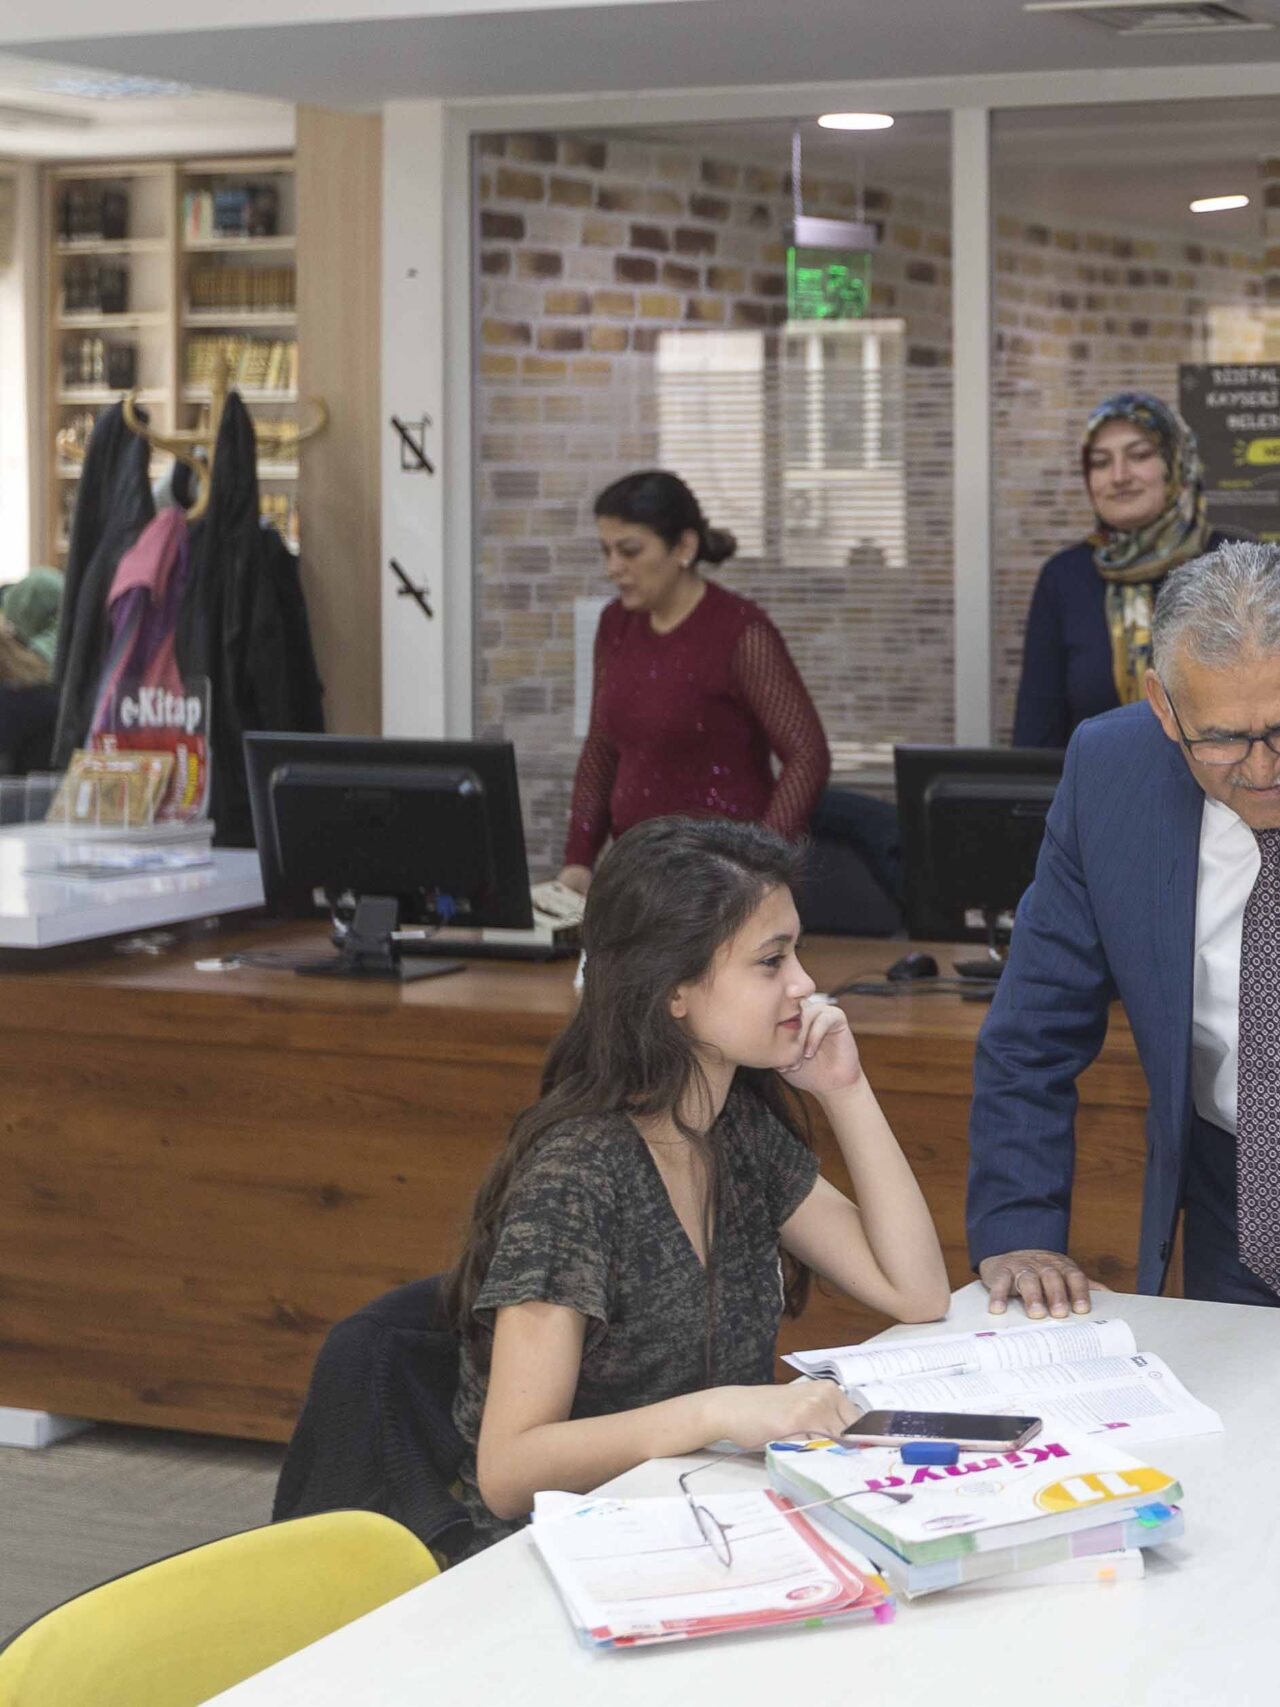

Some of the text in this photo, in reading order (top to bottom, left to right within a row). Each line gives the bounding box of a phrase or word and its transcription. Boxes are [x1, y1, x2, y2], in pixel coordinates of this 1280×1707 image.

[121, 687, 201, 734] e-Kitap
[865, 1443, 1070, 1491] Kimya
[1061, 1472, 1141, 1504] 11
